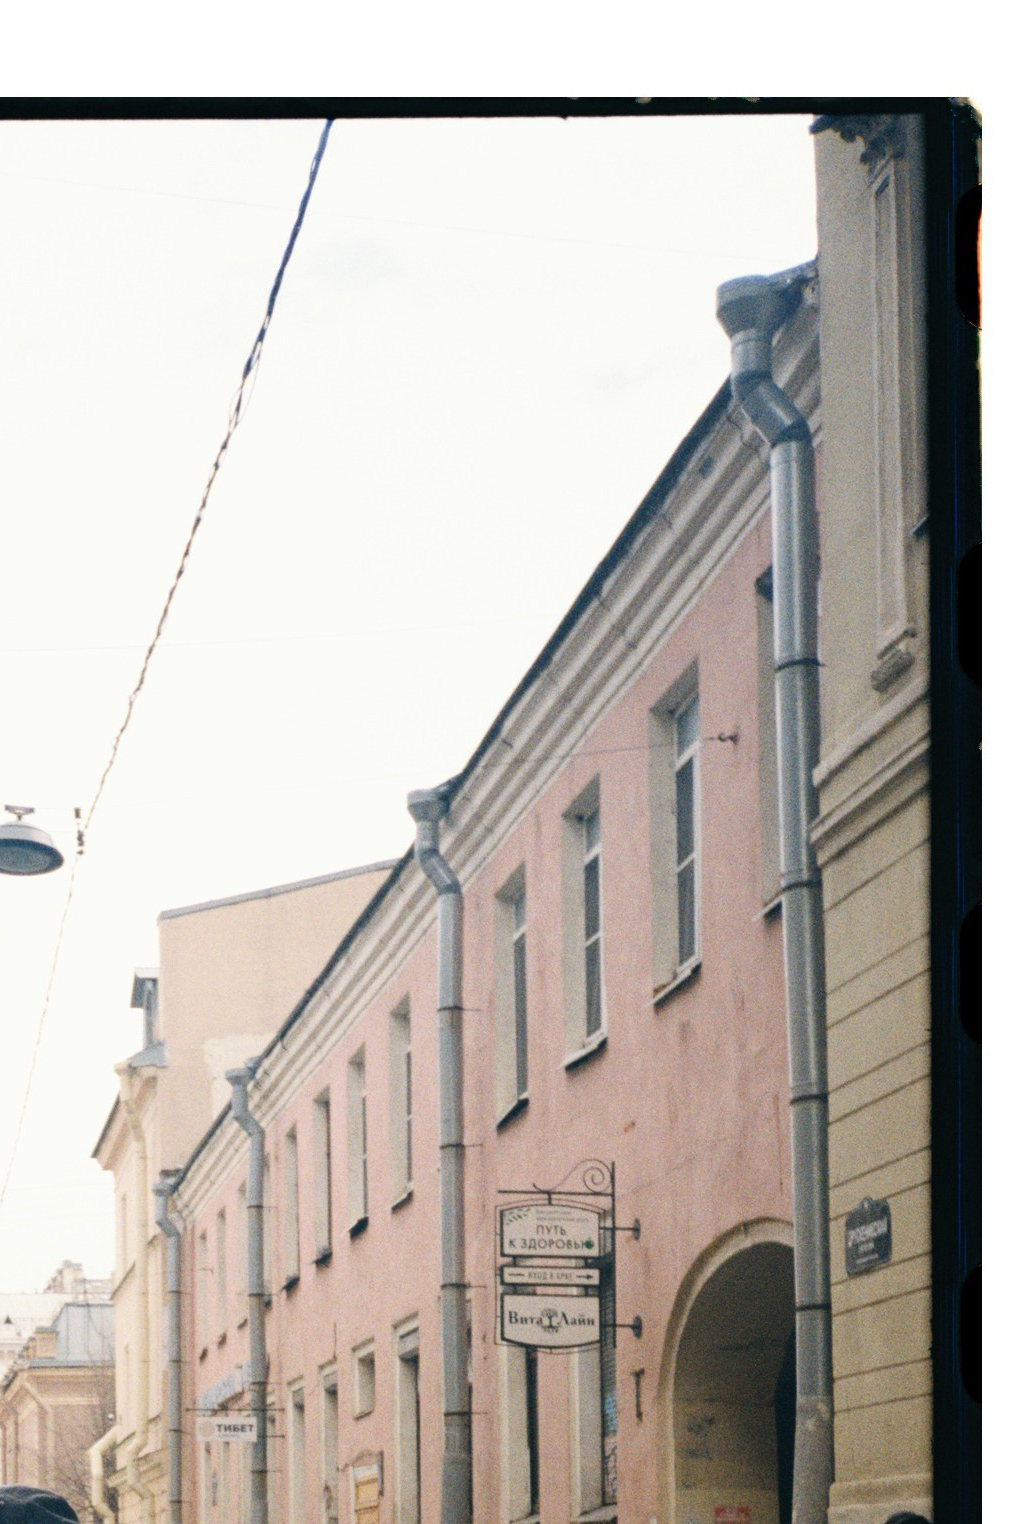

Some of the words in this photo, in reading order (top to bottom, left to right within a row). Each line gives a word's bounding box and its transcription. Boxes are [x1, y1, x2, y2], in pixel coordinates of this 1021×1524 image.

[536, 1225, 566, 1235] ПУТЬ
[509, 1238, 517, 1249] К
[508, 1311, 543, 1325] Вита
[556, 1311, 595, 1326] Лайн
[217, 1424, 254, 1432] ТИБЕТ
